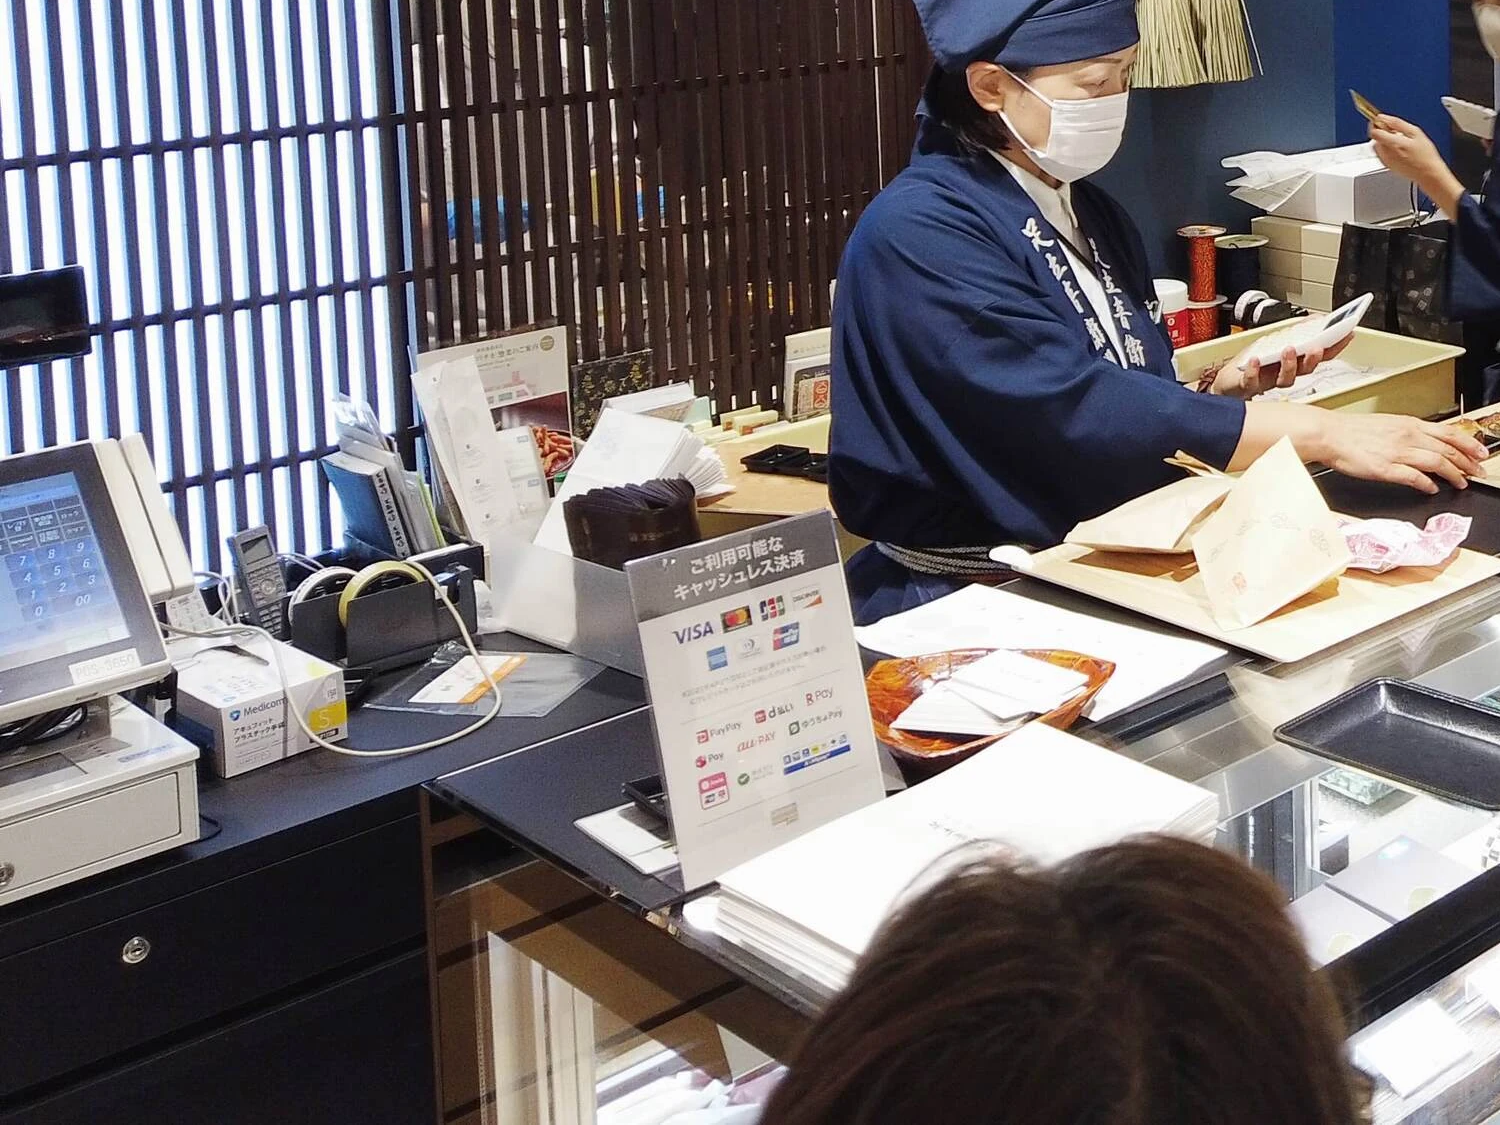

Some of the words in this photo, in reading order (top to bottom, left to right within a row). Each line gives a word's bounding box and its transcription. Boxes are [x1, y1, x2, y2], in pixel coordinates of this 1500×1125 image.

[19, 555, 26, 566] 7
[48, 549, 56, 559] 8
[77, 542, 85, 552] 9
[690, 535, 784, 575] ご利用可能な
[24, 572, 32, 583] 4
[53, 565, 61, 576] 5
[83, 558, 90, 568] 6
[673, 548, 806, 602] キャッシュレス決済
[30, 589, 36, 600] 1
[59, 582, 67, 593] 2
[88, 575, 96, 585] 3
[35, 607, 43, 617] 0
[75, 595, 91, 607] 00
[672, 621, 714, 645] VISA
[759, 595, 786, 622] JCB
[244, 697, 288, 717] Medicom
[318, 709, 331, 728] S
[709, 721, 744, 738] PayPay
[708, 752, 725, 763] Pay
